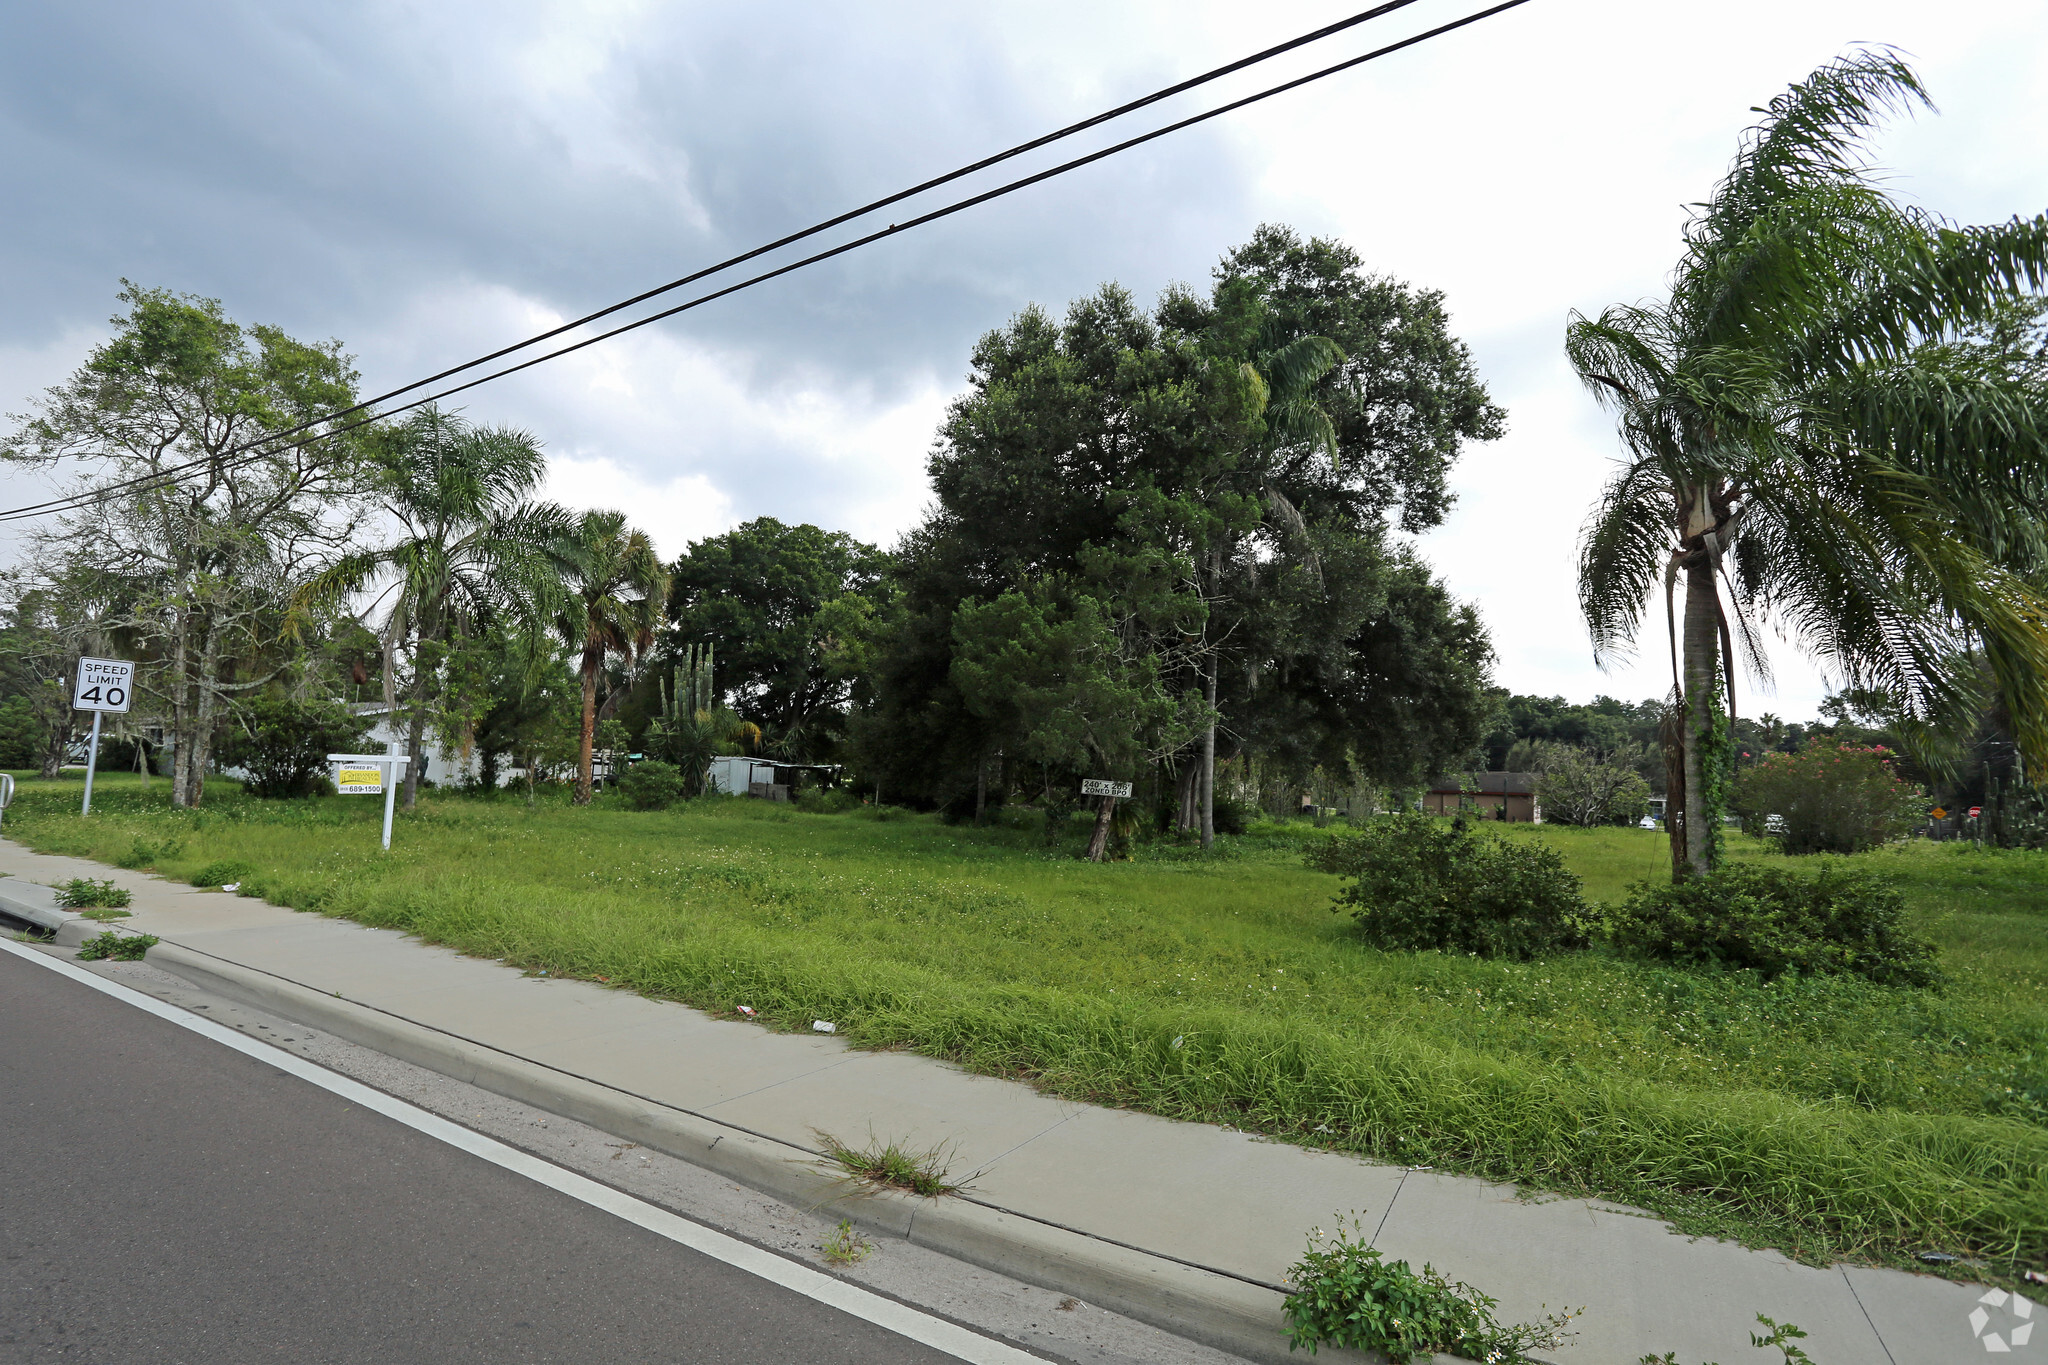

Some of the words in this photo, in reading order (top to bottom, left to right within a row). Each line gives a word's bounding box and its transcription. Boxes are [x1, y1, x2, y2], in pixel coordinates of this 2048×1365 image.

[85, 663, 128, 675] SPEED
[88, 675, 122, 685] LIMIT
[80, 686, 125, 706] 40
